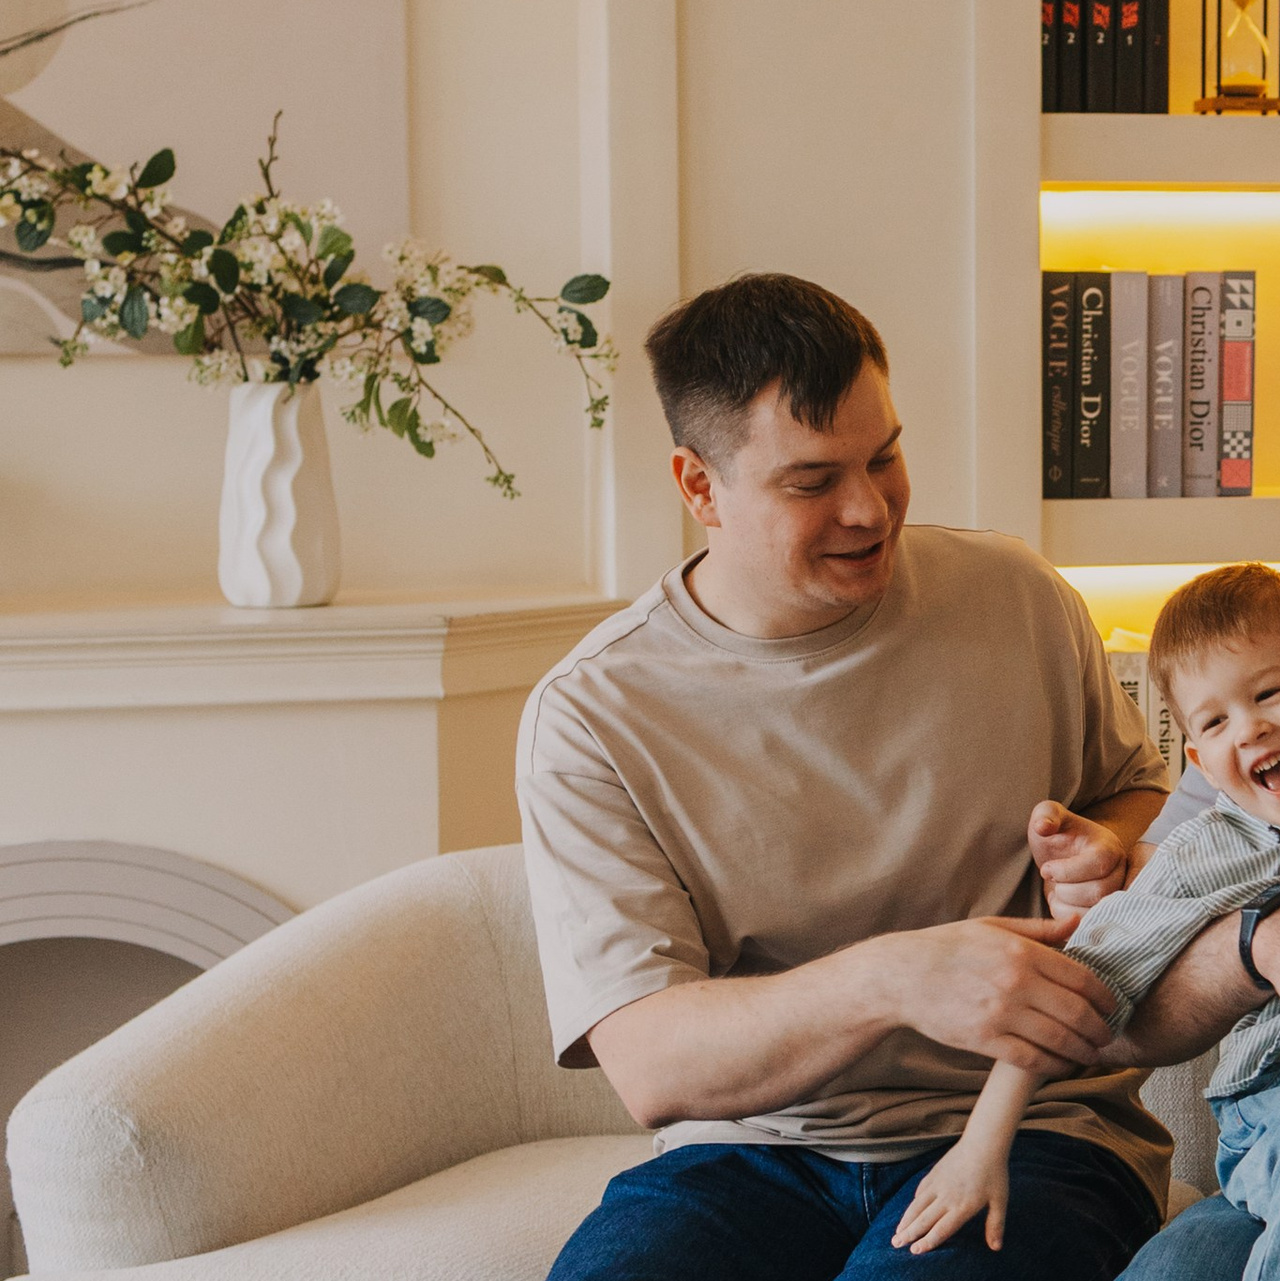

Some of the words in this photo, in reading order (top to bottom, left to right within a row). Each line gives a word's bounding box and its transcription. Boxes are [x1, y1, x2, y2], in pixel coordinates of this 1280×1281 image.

[1048, 284, 1070, 377] VOGUE
[1080, 287, 1103, 387] Christian
[1190, 286, 1212, 391] Christian
[1080, 393, 1102, 448] Dior
[1120, 339, 1141, 431] VOGUE
[1154, 339, 1174, 431] VOGUE
[1190, 400, 1211, 451] Dior
